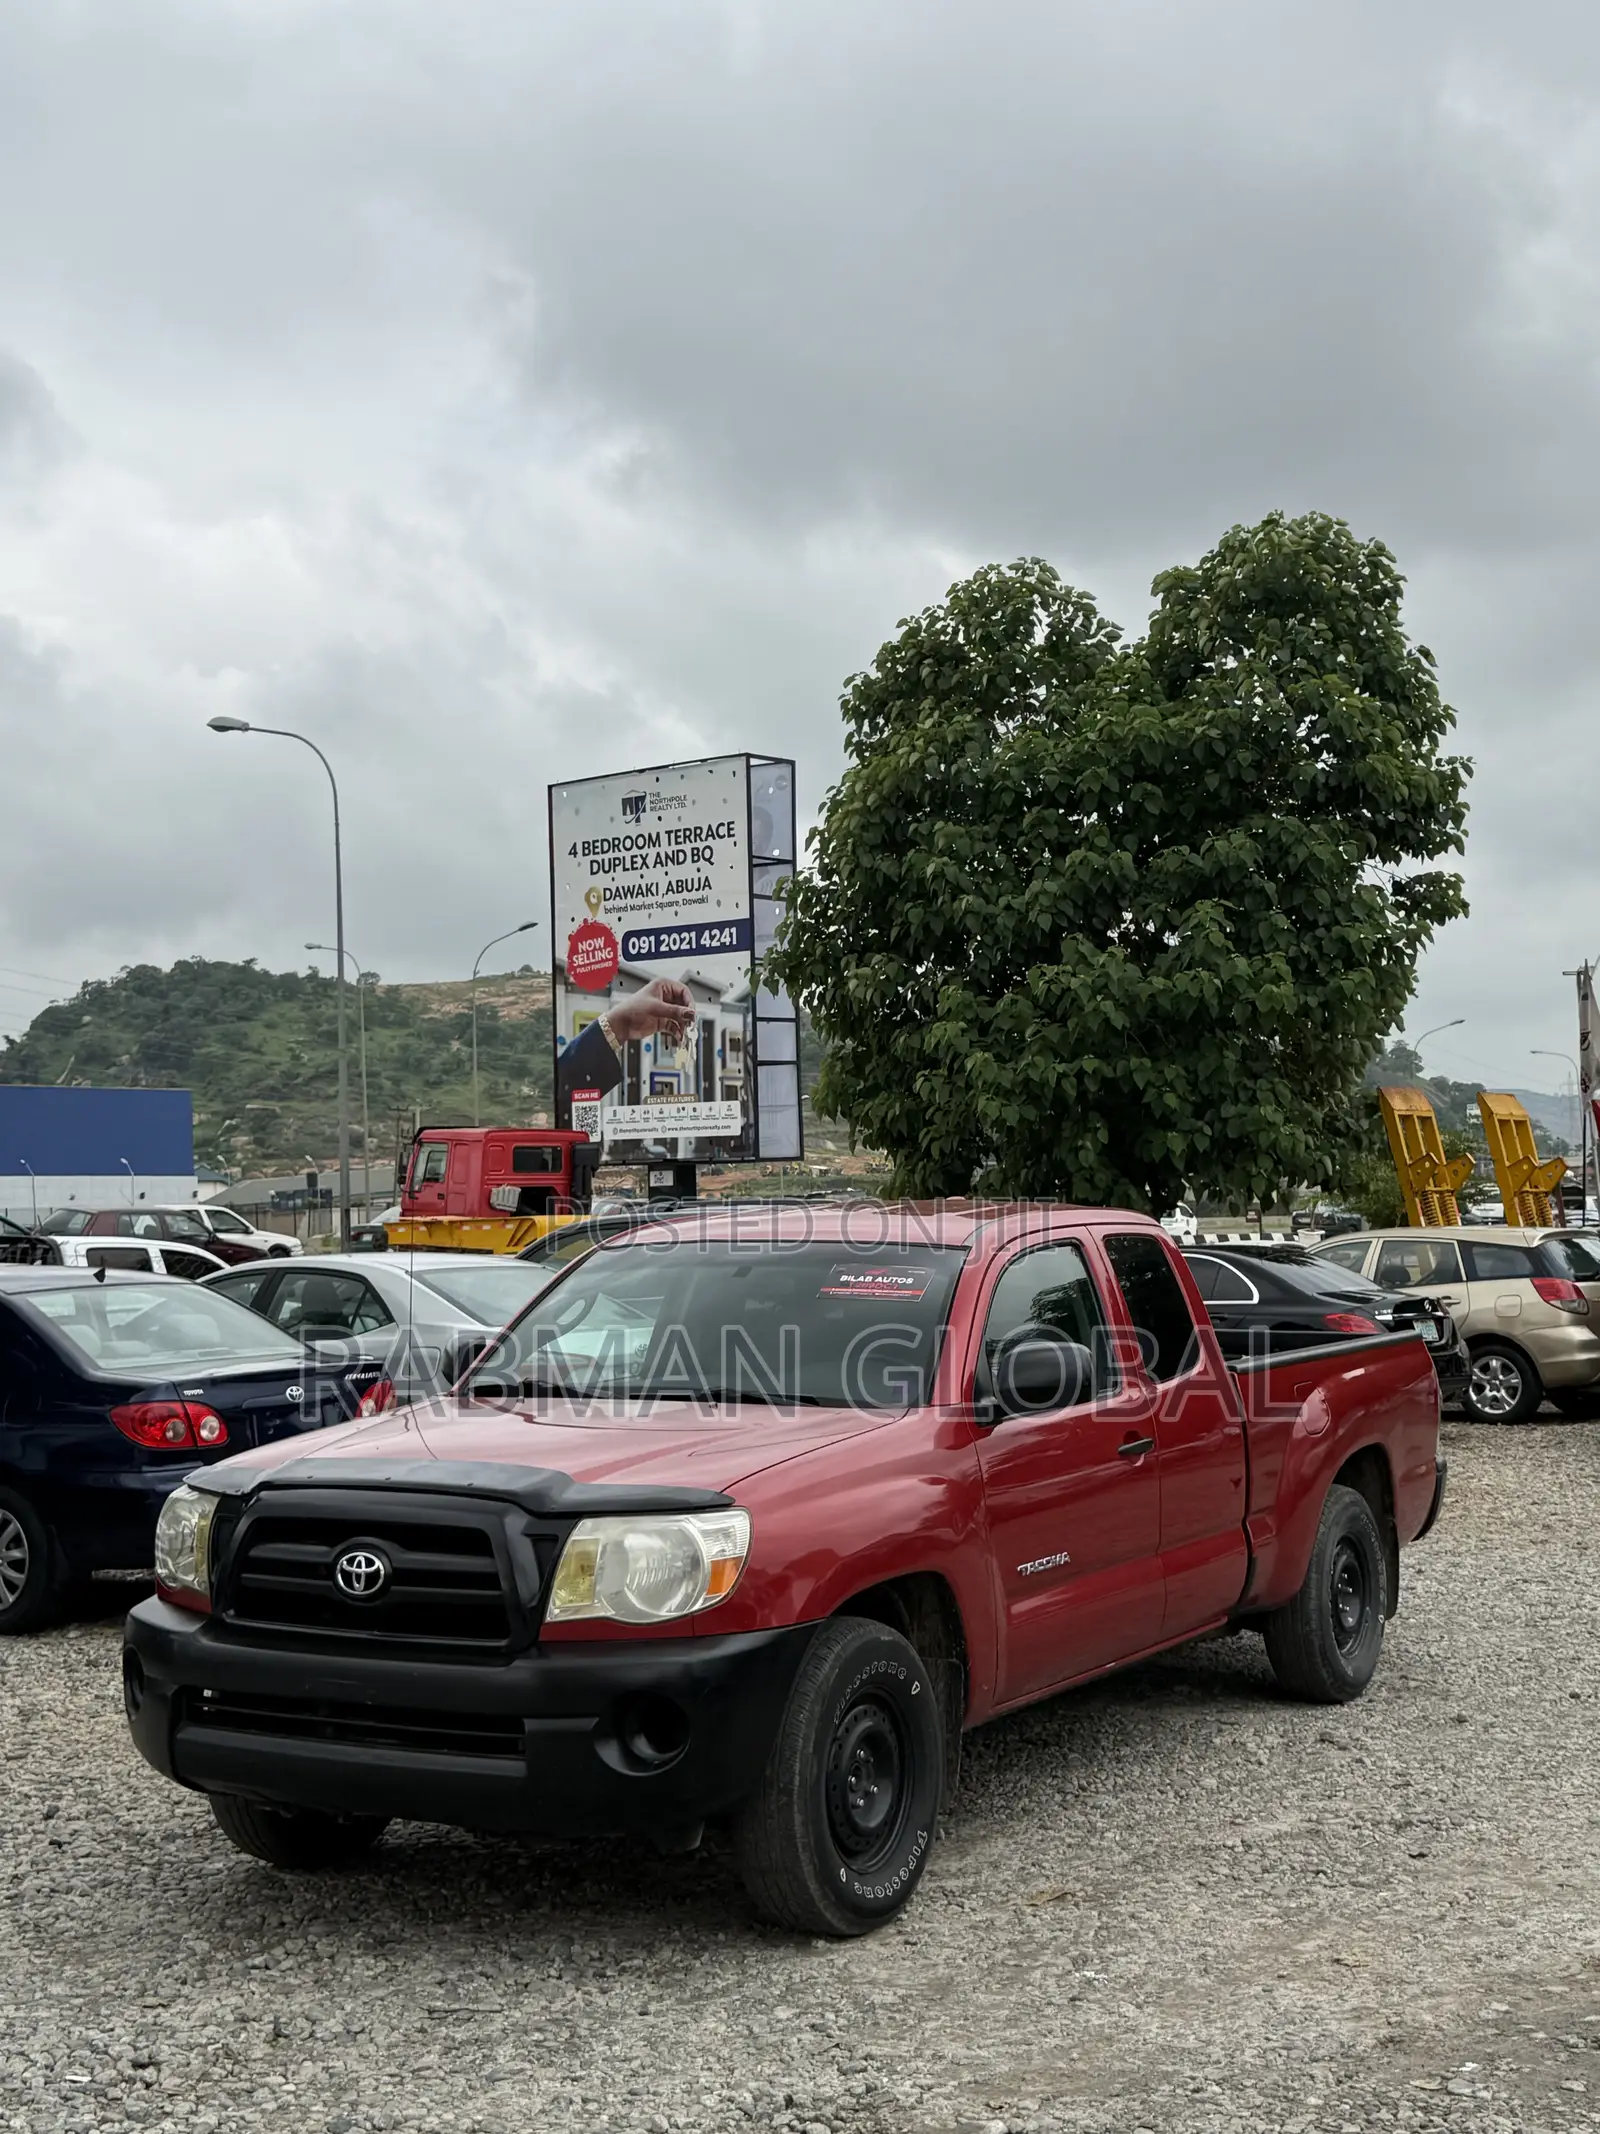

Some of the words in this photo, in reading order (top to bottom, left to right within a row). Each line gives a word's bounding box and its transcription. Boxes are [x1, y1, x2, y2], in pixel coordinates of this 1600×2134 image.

[649, 791, 661, 799] THE
[649, 794, 688, 806] NORTHPOLE
[649, 803, 672, 812] REALTY
[568, 842, 578, 859] 4
[582, 831, 661, 857] BEDROOM
[665, 820, 736, 847] TERRACE
[590, 852, 650, 876] DUPLEX
[652, 847, 687, 869] AND
[691, 845, 715, 867] BQ
[603, 881, 659, 902] DAWAKI
[604, 902, 629, 914] behind
[629, 901, 654, 911] Market
[655, 899, 681, 911] Square,
[682, 895, 709, 906] Dawaki
[577, 936, 605, 953] NOW
[628, 935, 656, 956] 091
[659, 930, 697, 951] 2021
[700, 926, 737, 948] 4241
[572, 947, 614, 967] SELLING
[574, 1092, 590, 1100] SCAN
[590, 1091, 598, 1099] ME
[667, 1095, 695, 1103] FEATURES
[874, 1275, 914, 1284] AUTOS
[183, 1388, 204, 1397] TOYOTA
